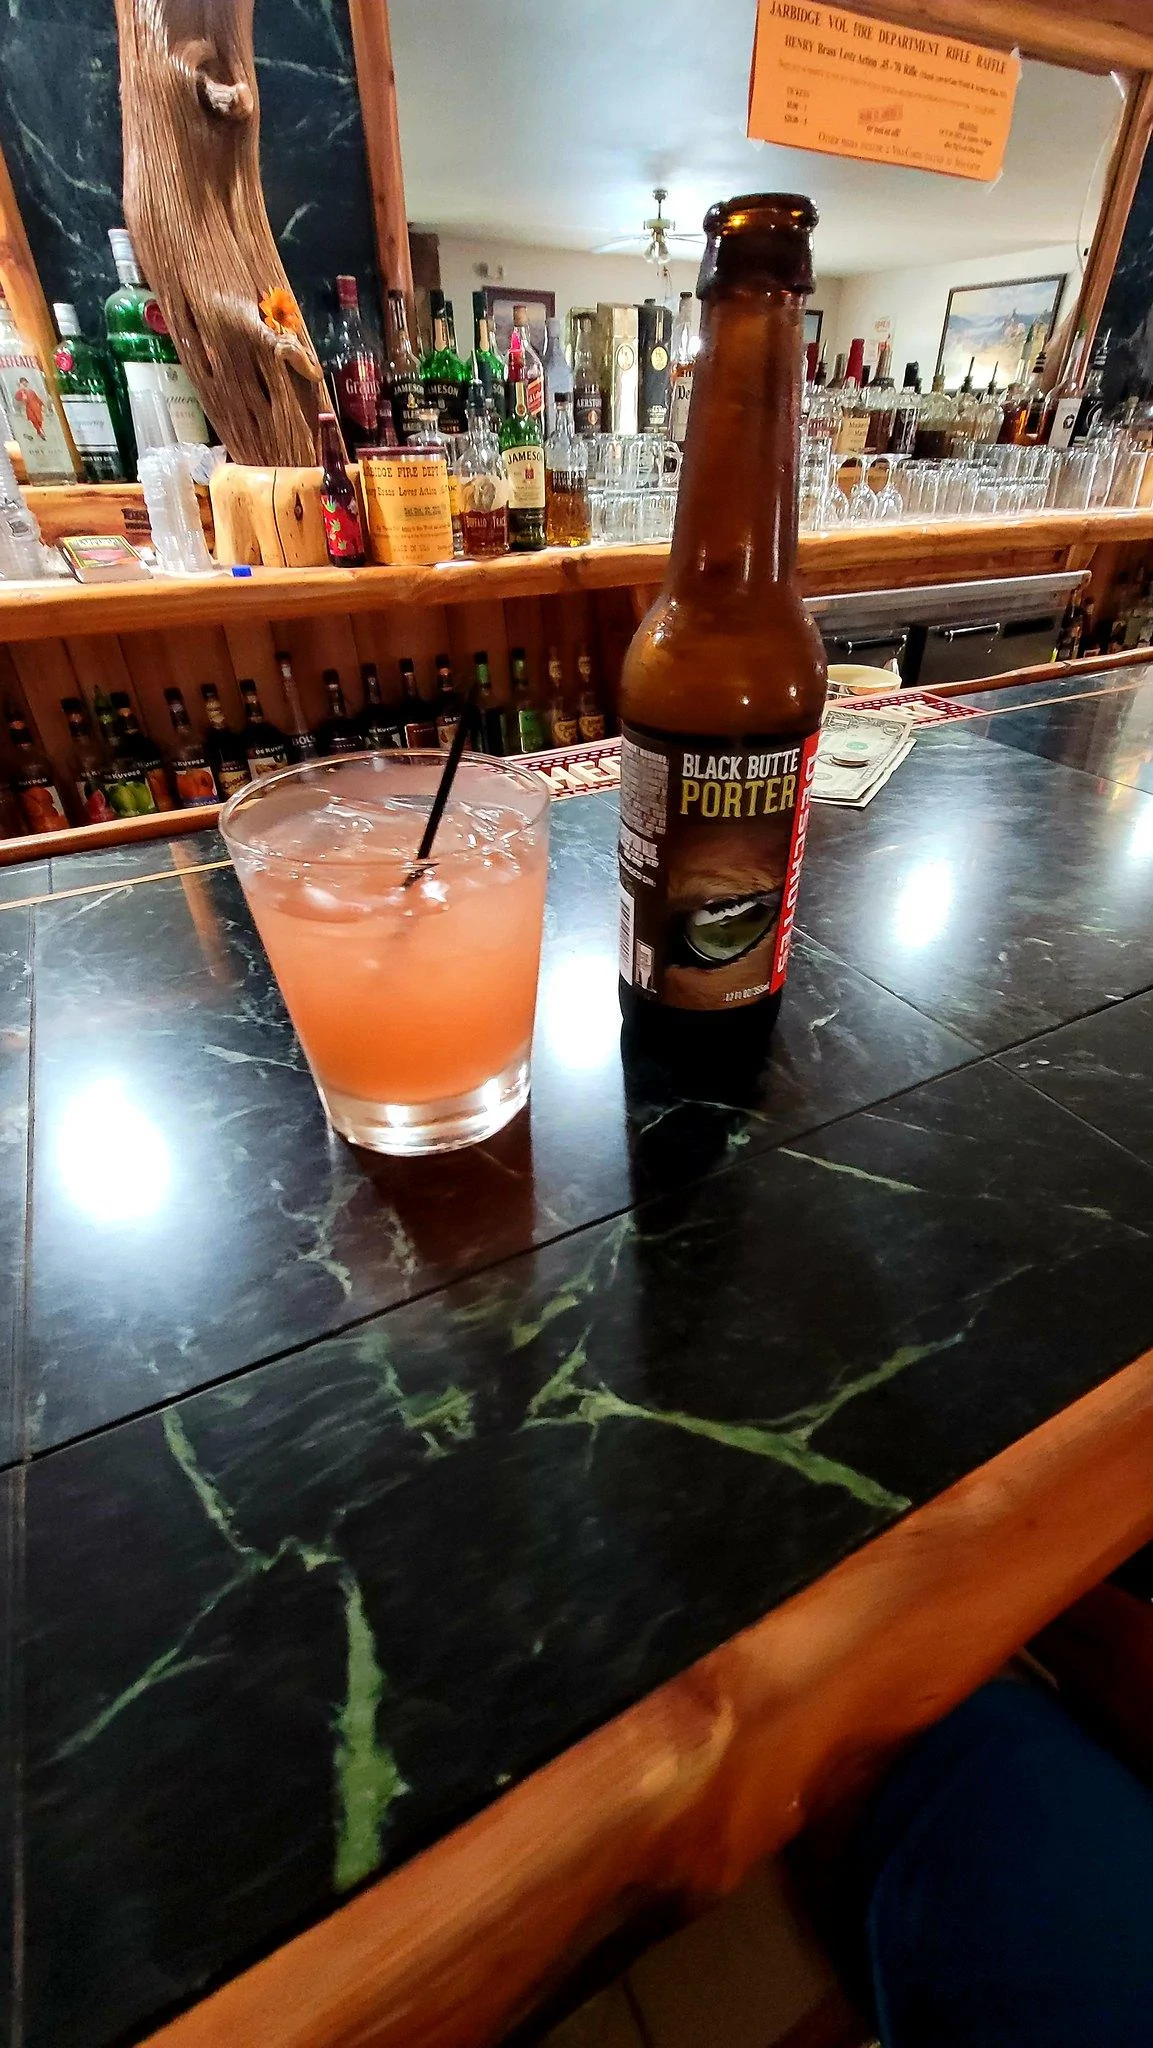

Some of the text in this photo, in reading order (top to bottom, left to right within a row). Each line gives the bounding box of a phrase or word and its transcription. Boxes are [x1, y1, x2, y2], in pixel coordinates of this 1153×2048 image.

[770, 1, 1006, 75] JARBIDGE VOL FIRE DEPARTMENT RIFLE RAFFLE
[785, 34, 814, 52] HENRY
[397, 466, 418, 478] FIRE
[682, 747, 800, 780] BLACK BUTTE
[680, 774, 797, 818] PORTER
